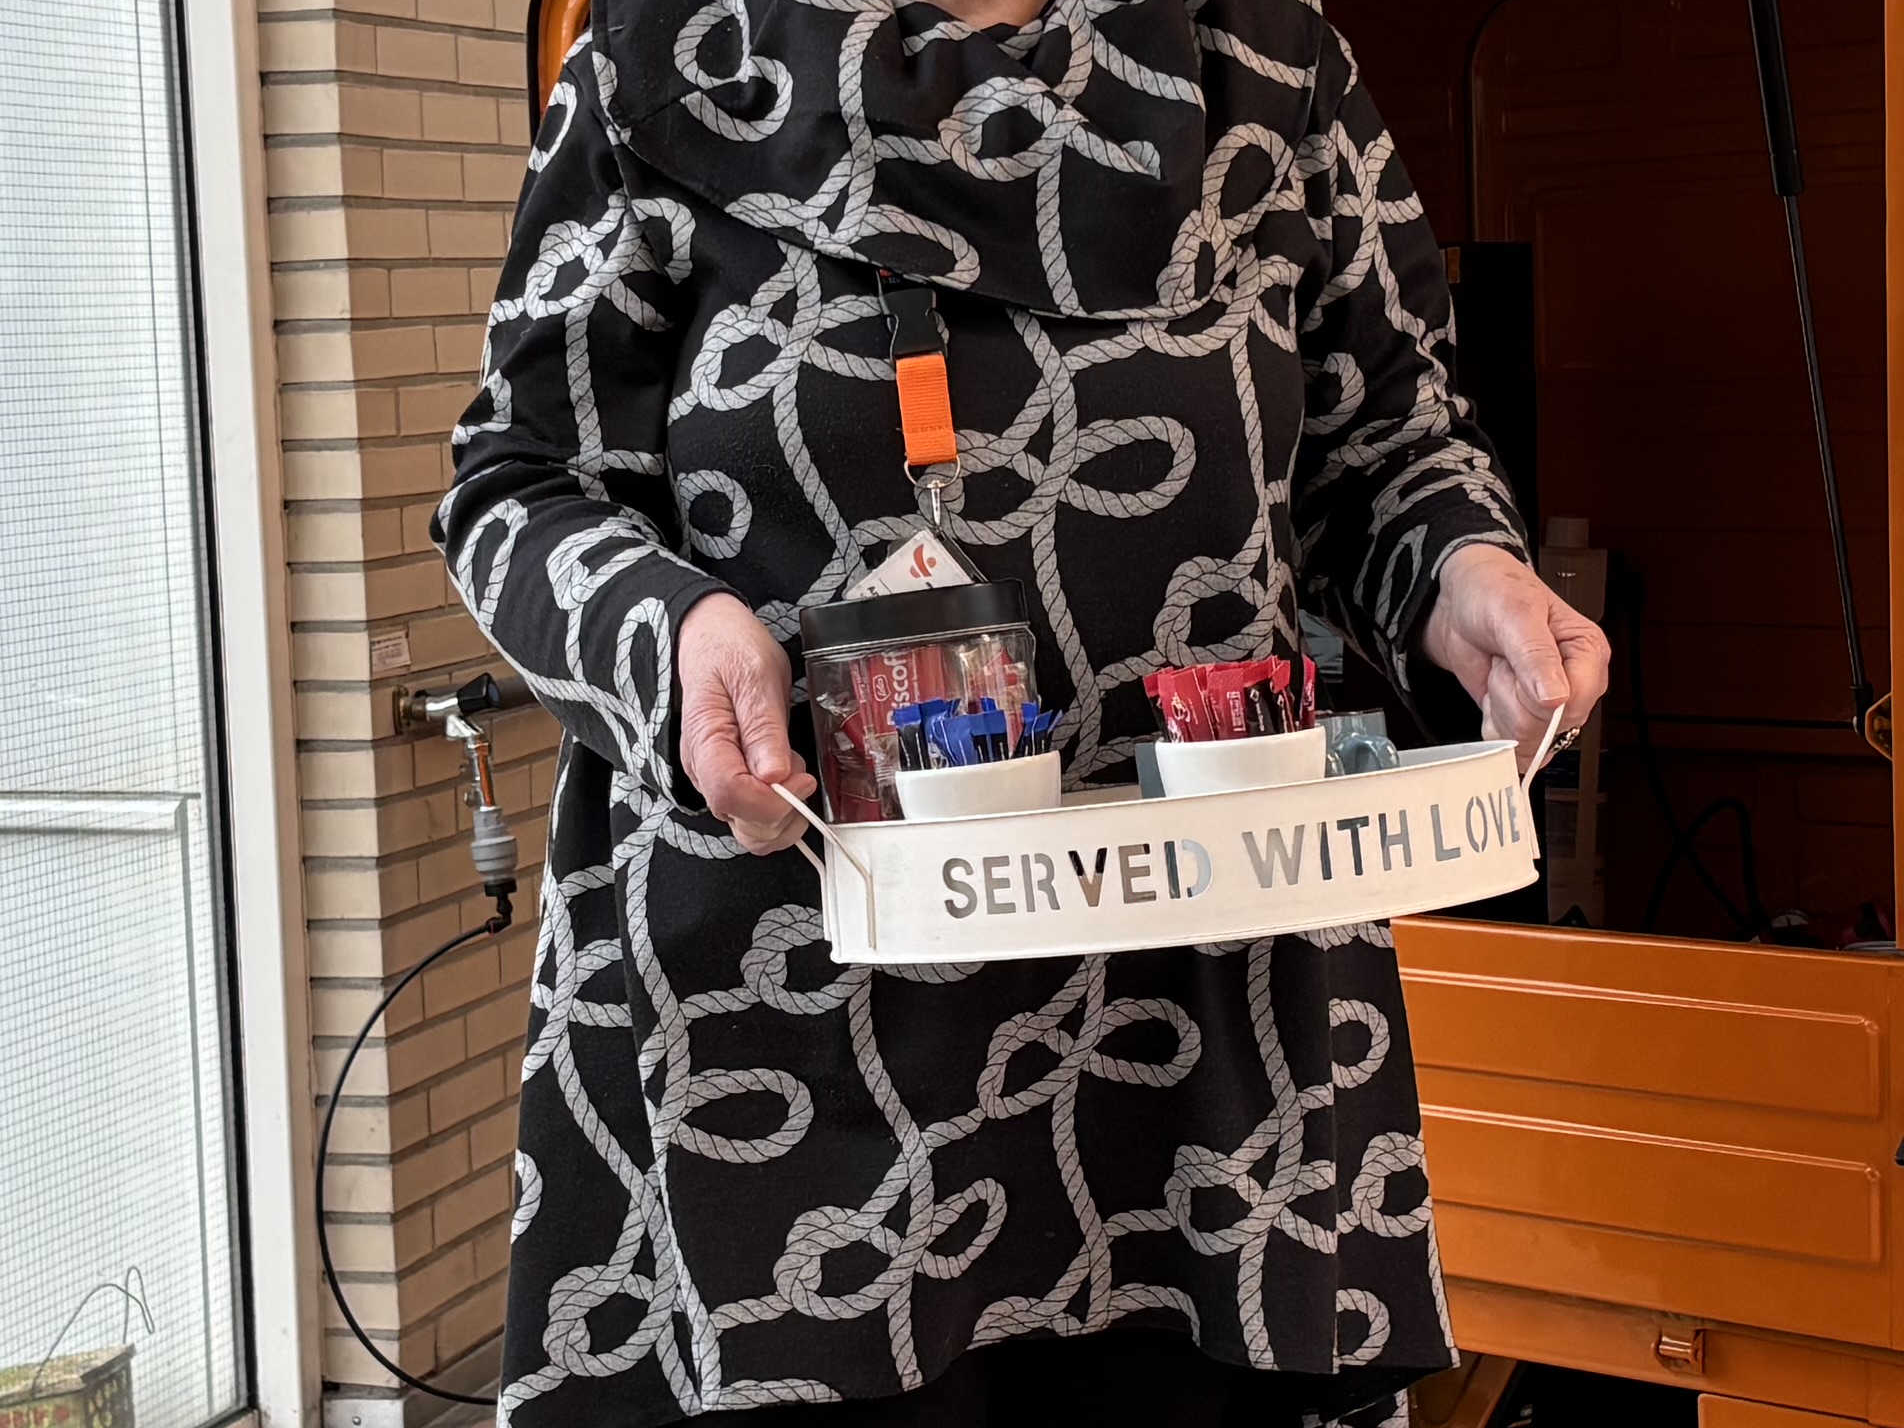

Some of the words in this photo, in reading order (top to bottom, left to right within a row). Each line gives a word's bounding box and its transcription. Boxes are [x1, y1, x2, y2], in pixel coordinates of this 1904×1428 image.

[882, 651, 911, 726] iscof
[942, 838, 1214, 920] SERVED
[1242, 809, 1413, 889] WITH
[1431, 785, 1521, 863] LOVE
